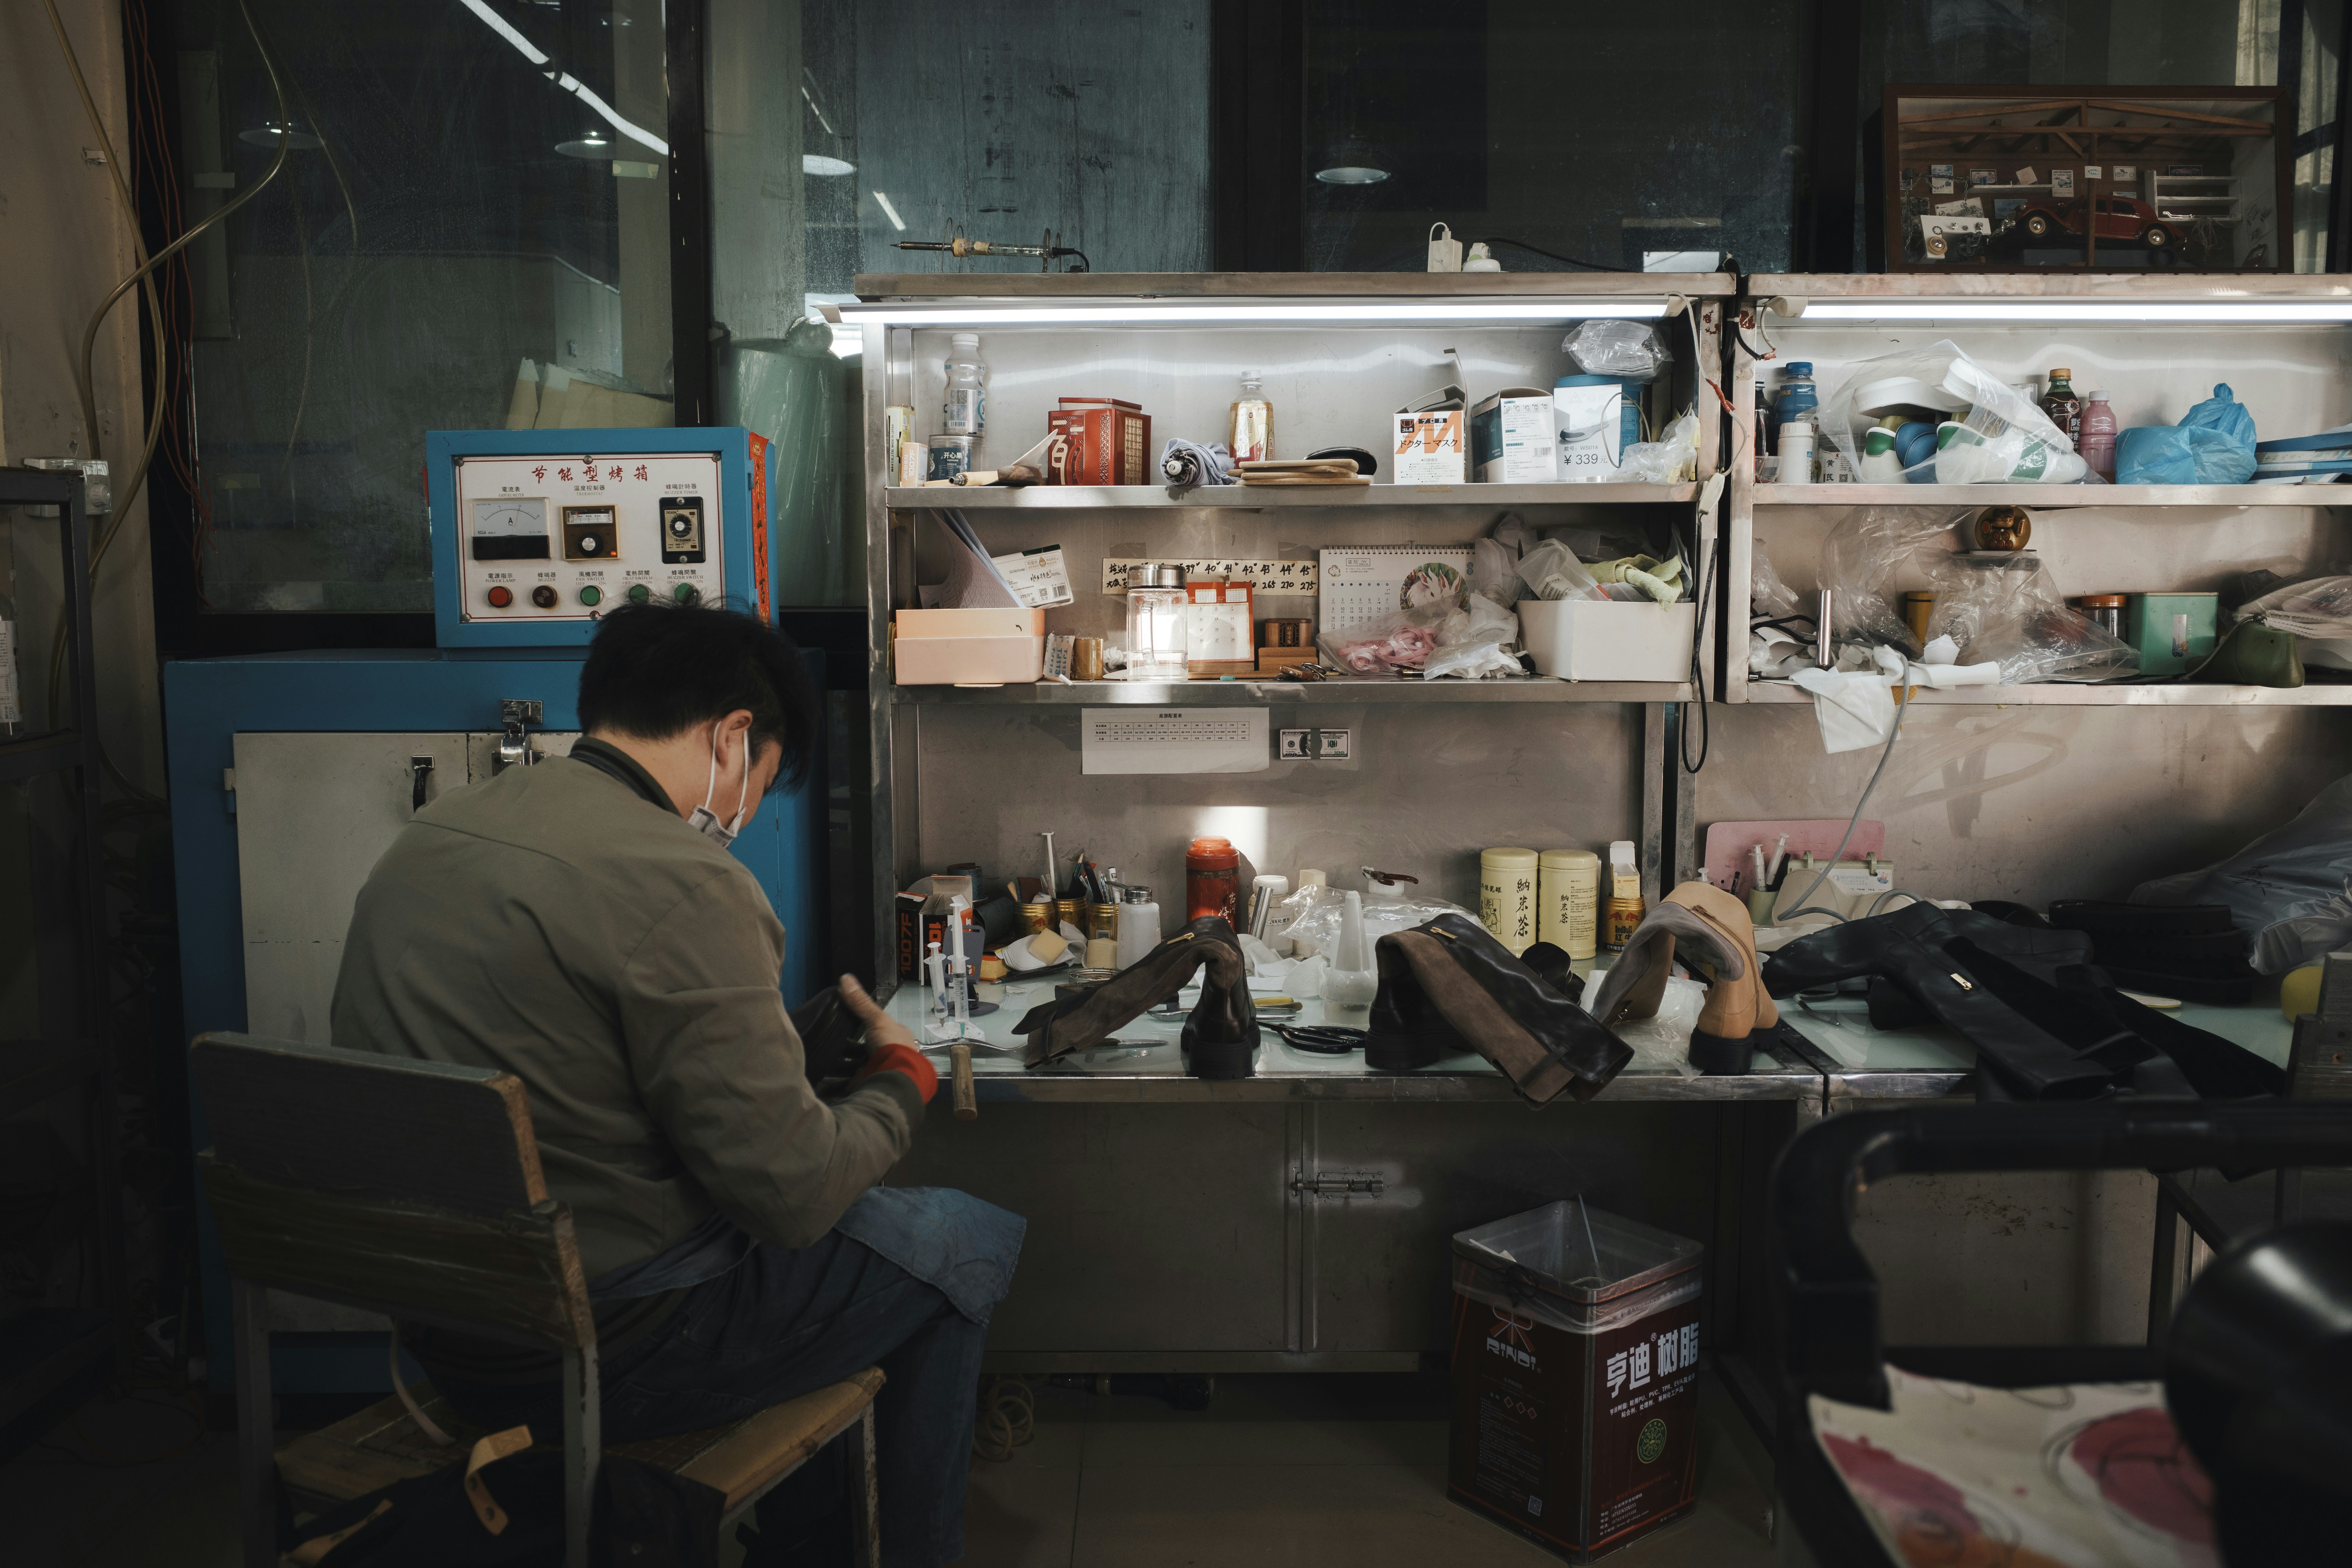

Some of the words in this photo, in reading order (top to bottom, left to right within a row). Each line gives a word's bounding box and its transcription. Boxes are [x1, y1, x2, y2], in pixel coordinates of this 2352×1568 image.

[1400, 439, 1431, 448] ドクター
[1576, 454, 1598, 464] 339
[1826, 459, 1835, 481] 黄芪
[531, 465, 648, 484] 节能型烤箱
[1186, 565, 1195, 574] 39
[1205, 564, 1216, 574] 40
[1224, 564, 1232, 574] 41
[1242, 565, 1254, 575] 42
[1260, 564, 1270, 575] 43
[1280, 565, 1292, 576] 44
[1300, 565, 1309, 576] 45
[1262, 580, 1276, 589] 265
[1281, 581, 1294, 590] 270
[1300, 581, 1316, 590] 275
[1512, 878, 1530, 937] 納米茶
[1559, 894, 1569, 924] 納米茶
[1615, 925, 1632, 934] RedBull
[901, 912, 912, 975] 1007F
[1487, 1337, 1536, 1370] RINDI
[1607, 1342, 1650, 1399] 亨迪
[1657, 1321, 1699, 1377] 树脂
[1621, 1408, 1637, 1418] 粘合剂、
[1639, 1400, 1655, 1411] 处理剂、
[1658, 1386, 1684, 1402] 系列化工产品
